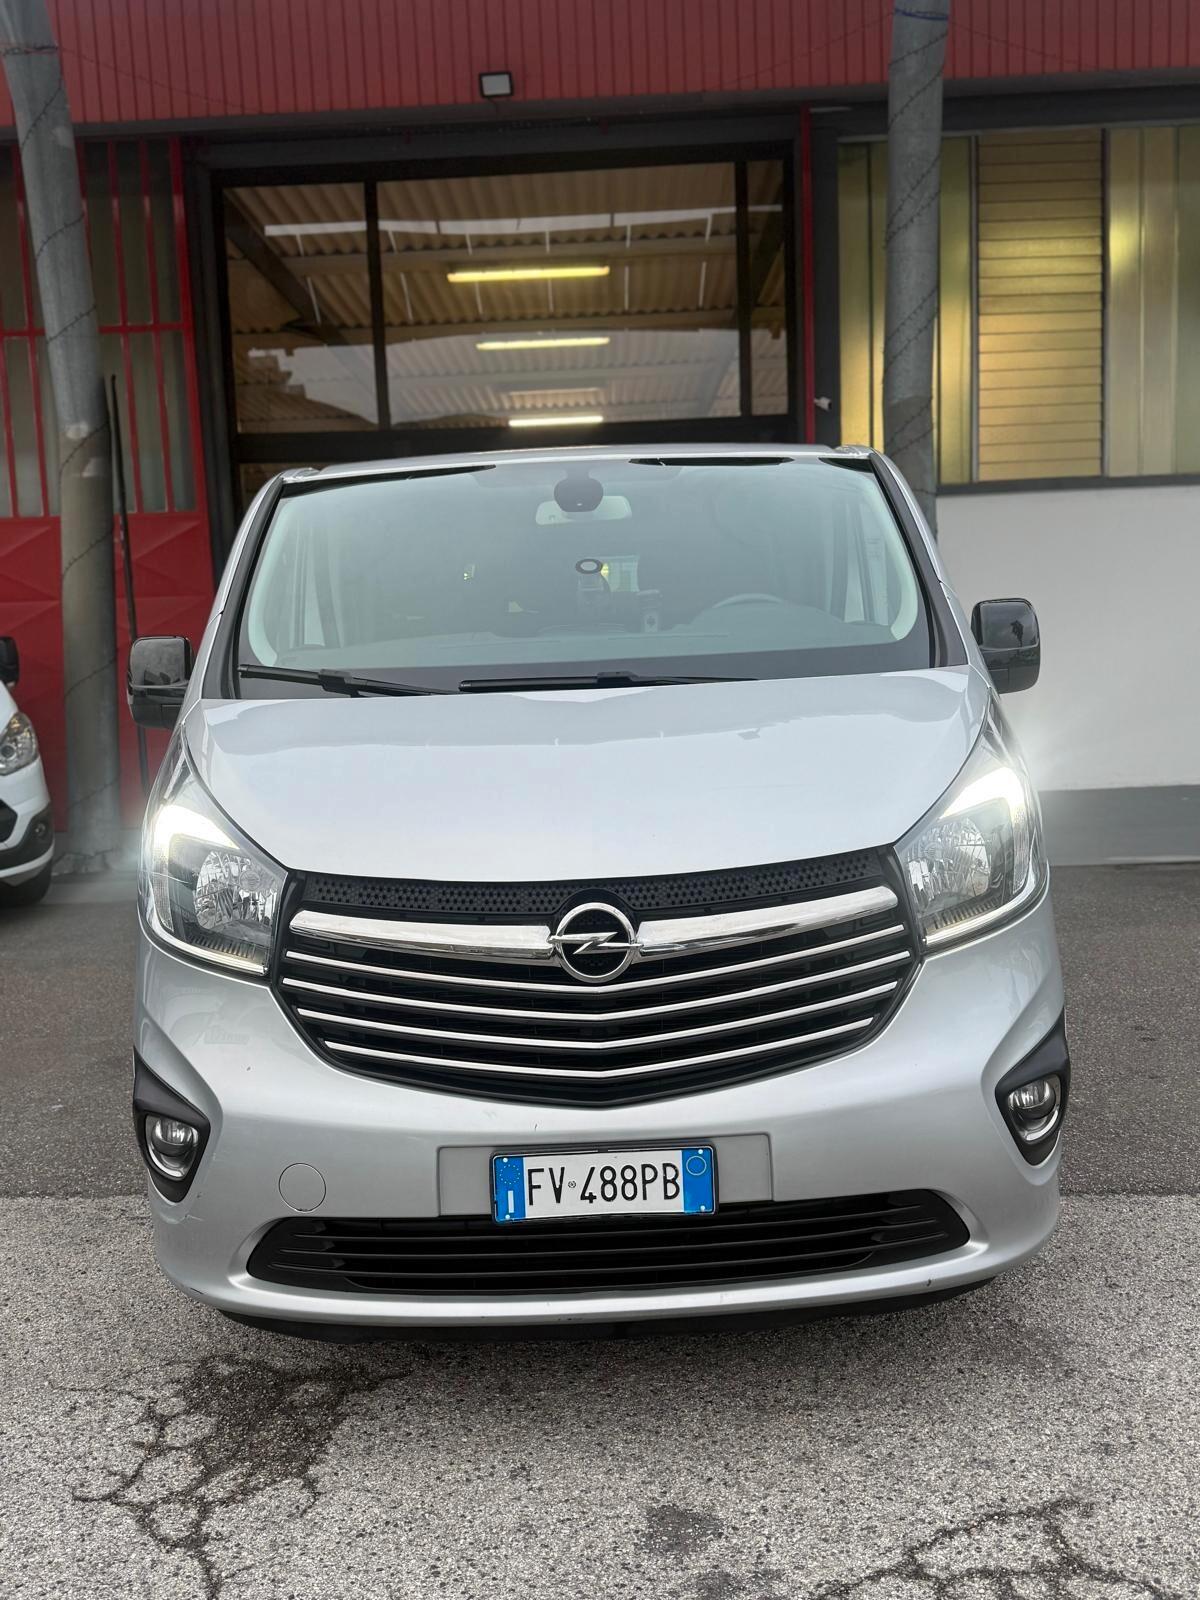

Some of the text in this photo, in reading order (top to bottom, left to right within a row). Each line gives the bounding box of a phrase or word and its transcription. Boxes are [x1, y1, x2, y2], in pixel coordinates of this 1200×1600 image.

[527, 1162, 681, 1206] FV 488PB
[507, 1190, 515, 1213] I
